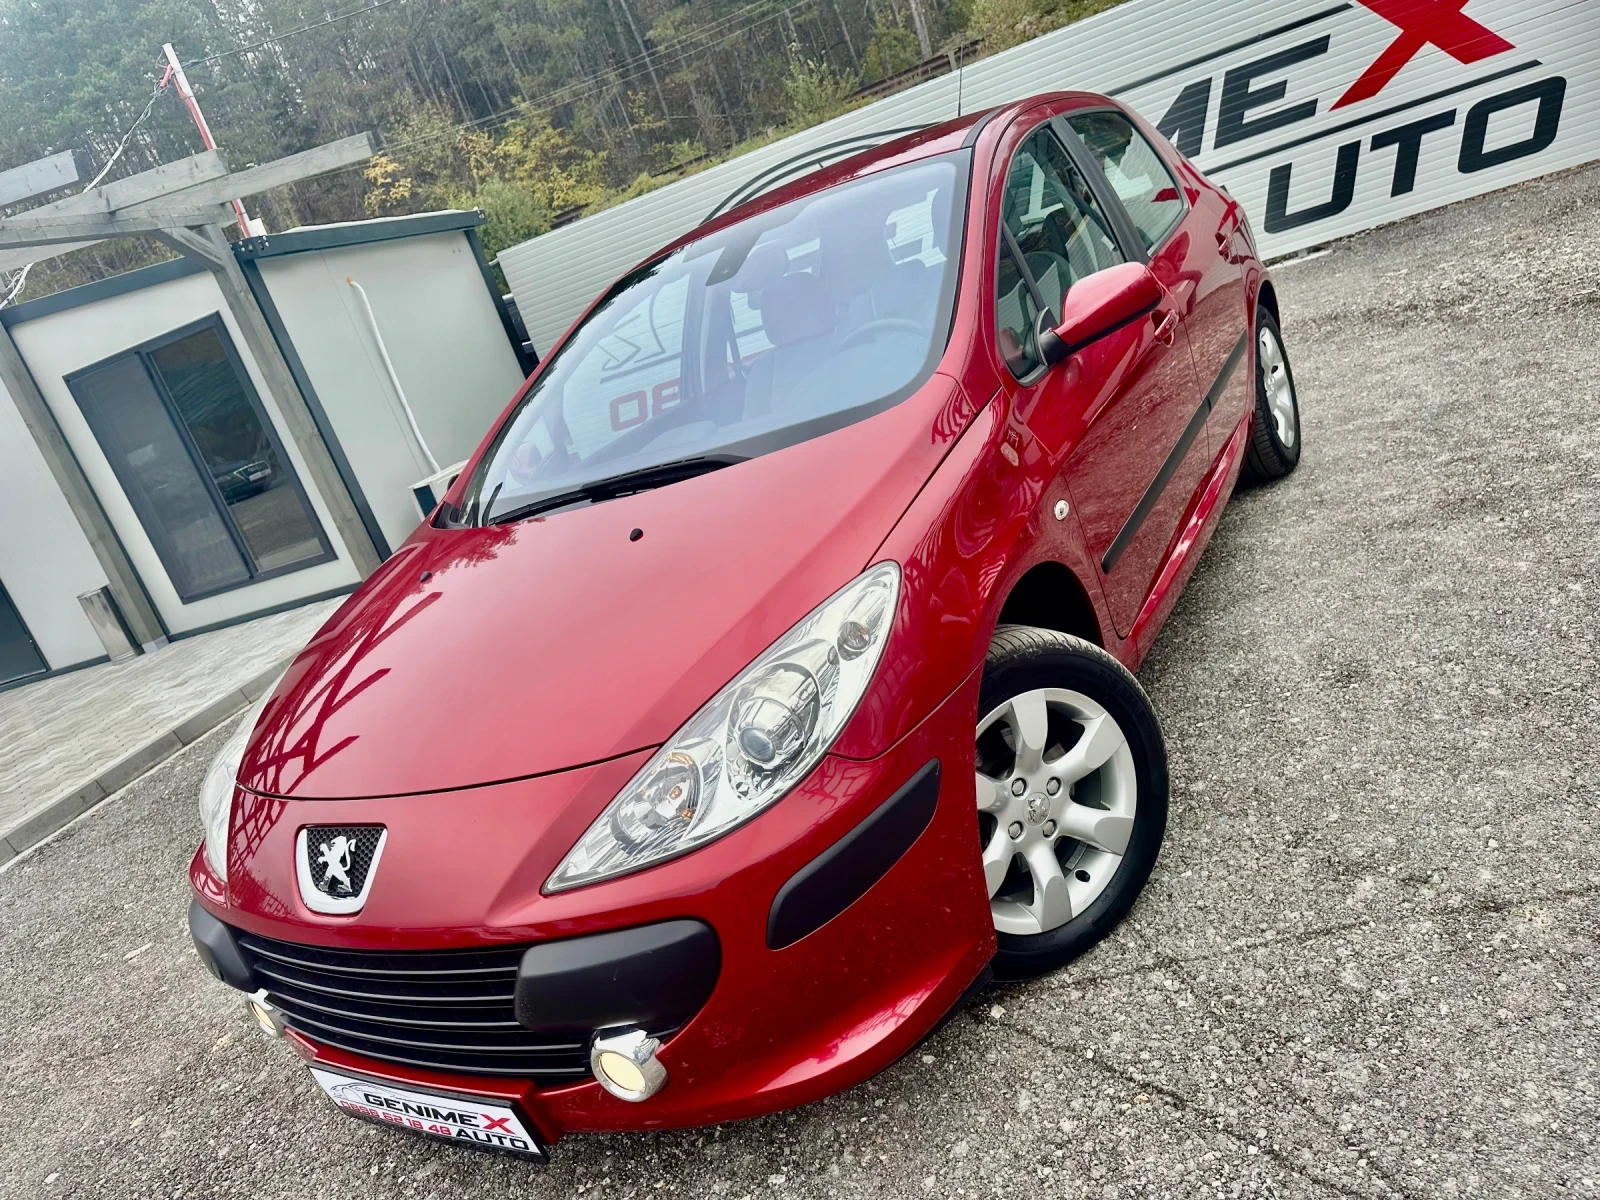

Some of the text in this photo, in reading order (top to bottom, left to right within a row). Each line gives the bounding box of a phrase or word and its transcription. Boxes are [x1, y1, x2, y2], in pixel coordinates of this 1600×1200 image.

[1264, 76, 1567, 234] UTO
[363, 1092, 517, 1136] GENIMEX
[406, 1118, 424, 1130] 18
[428, 1124, 452, 1136] 48
[456, 1128, 530, 1151] AUTO
